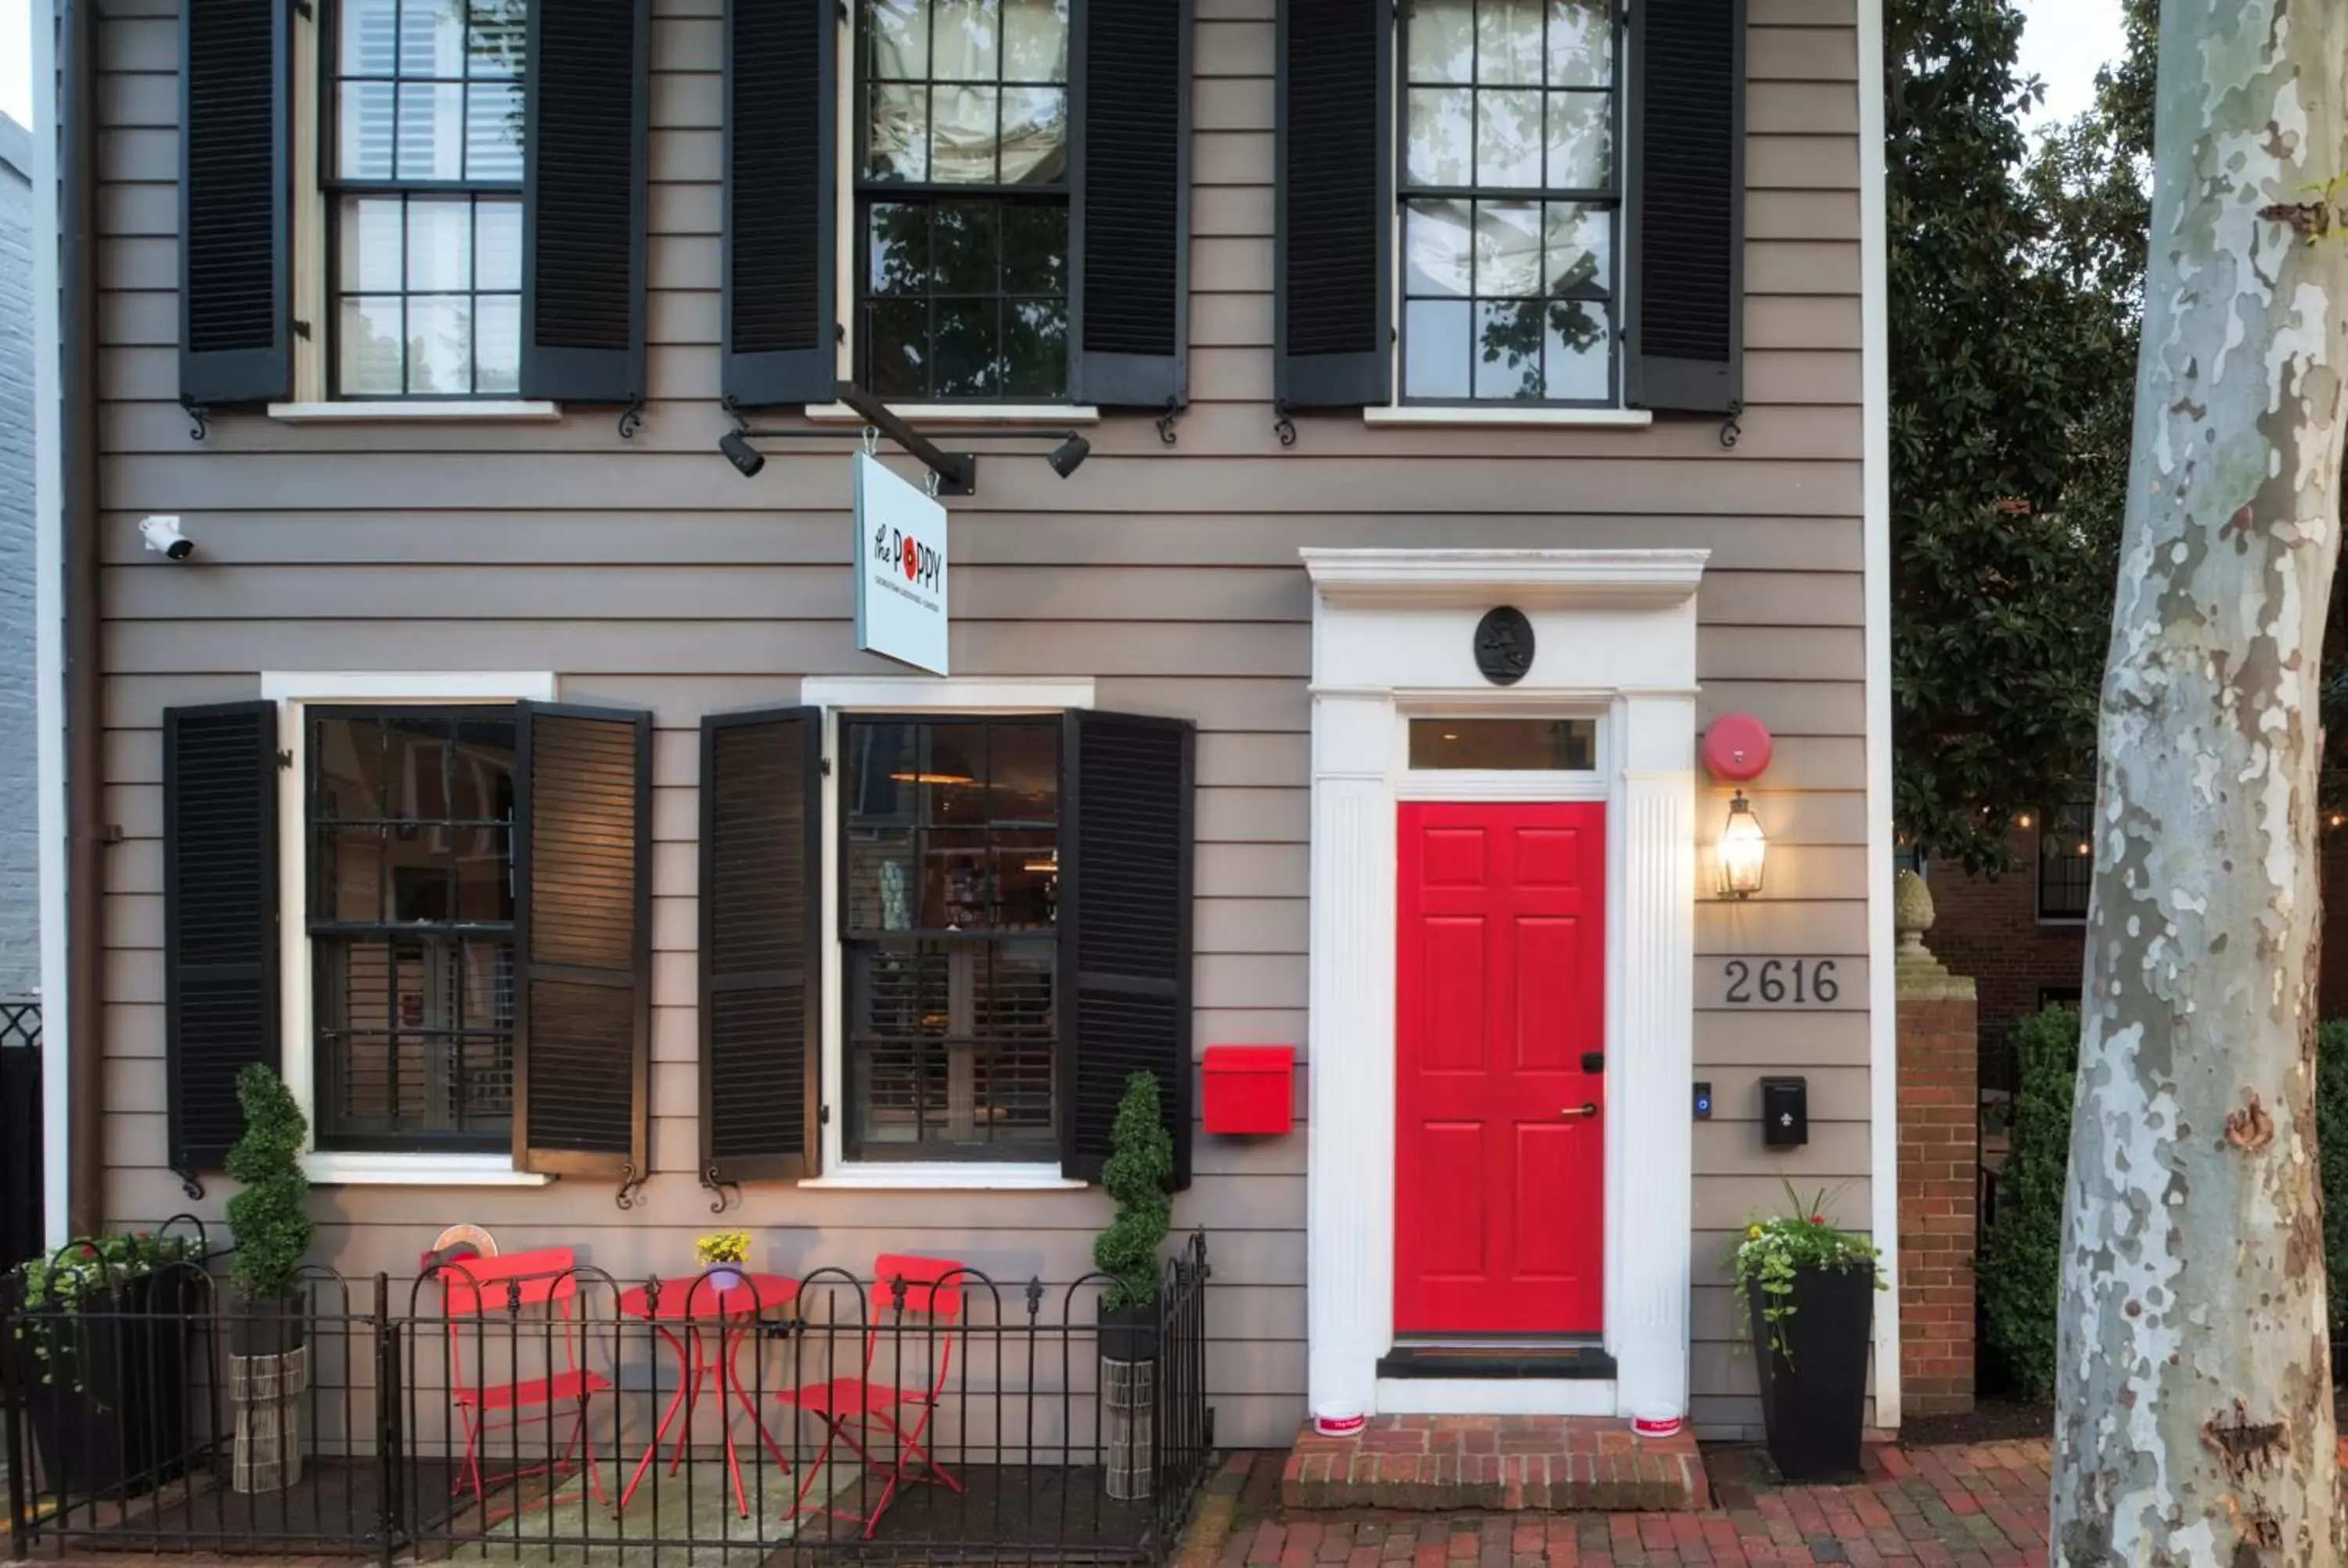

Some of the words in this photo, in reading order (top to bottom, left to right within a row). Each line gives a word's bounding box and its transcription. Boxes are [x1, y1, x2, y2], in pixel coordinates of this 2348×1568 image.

[874, 523, 890, 563] the
[893, 527, 942, 594] POPPY
[1724, 959, 1839, 1003] 2616
